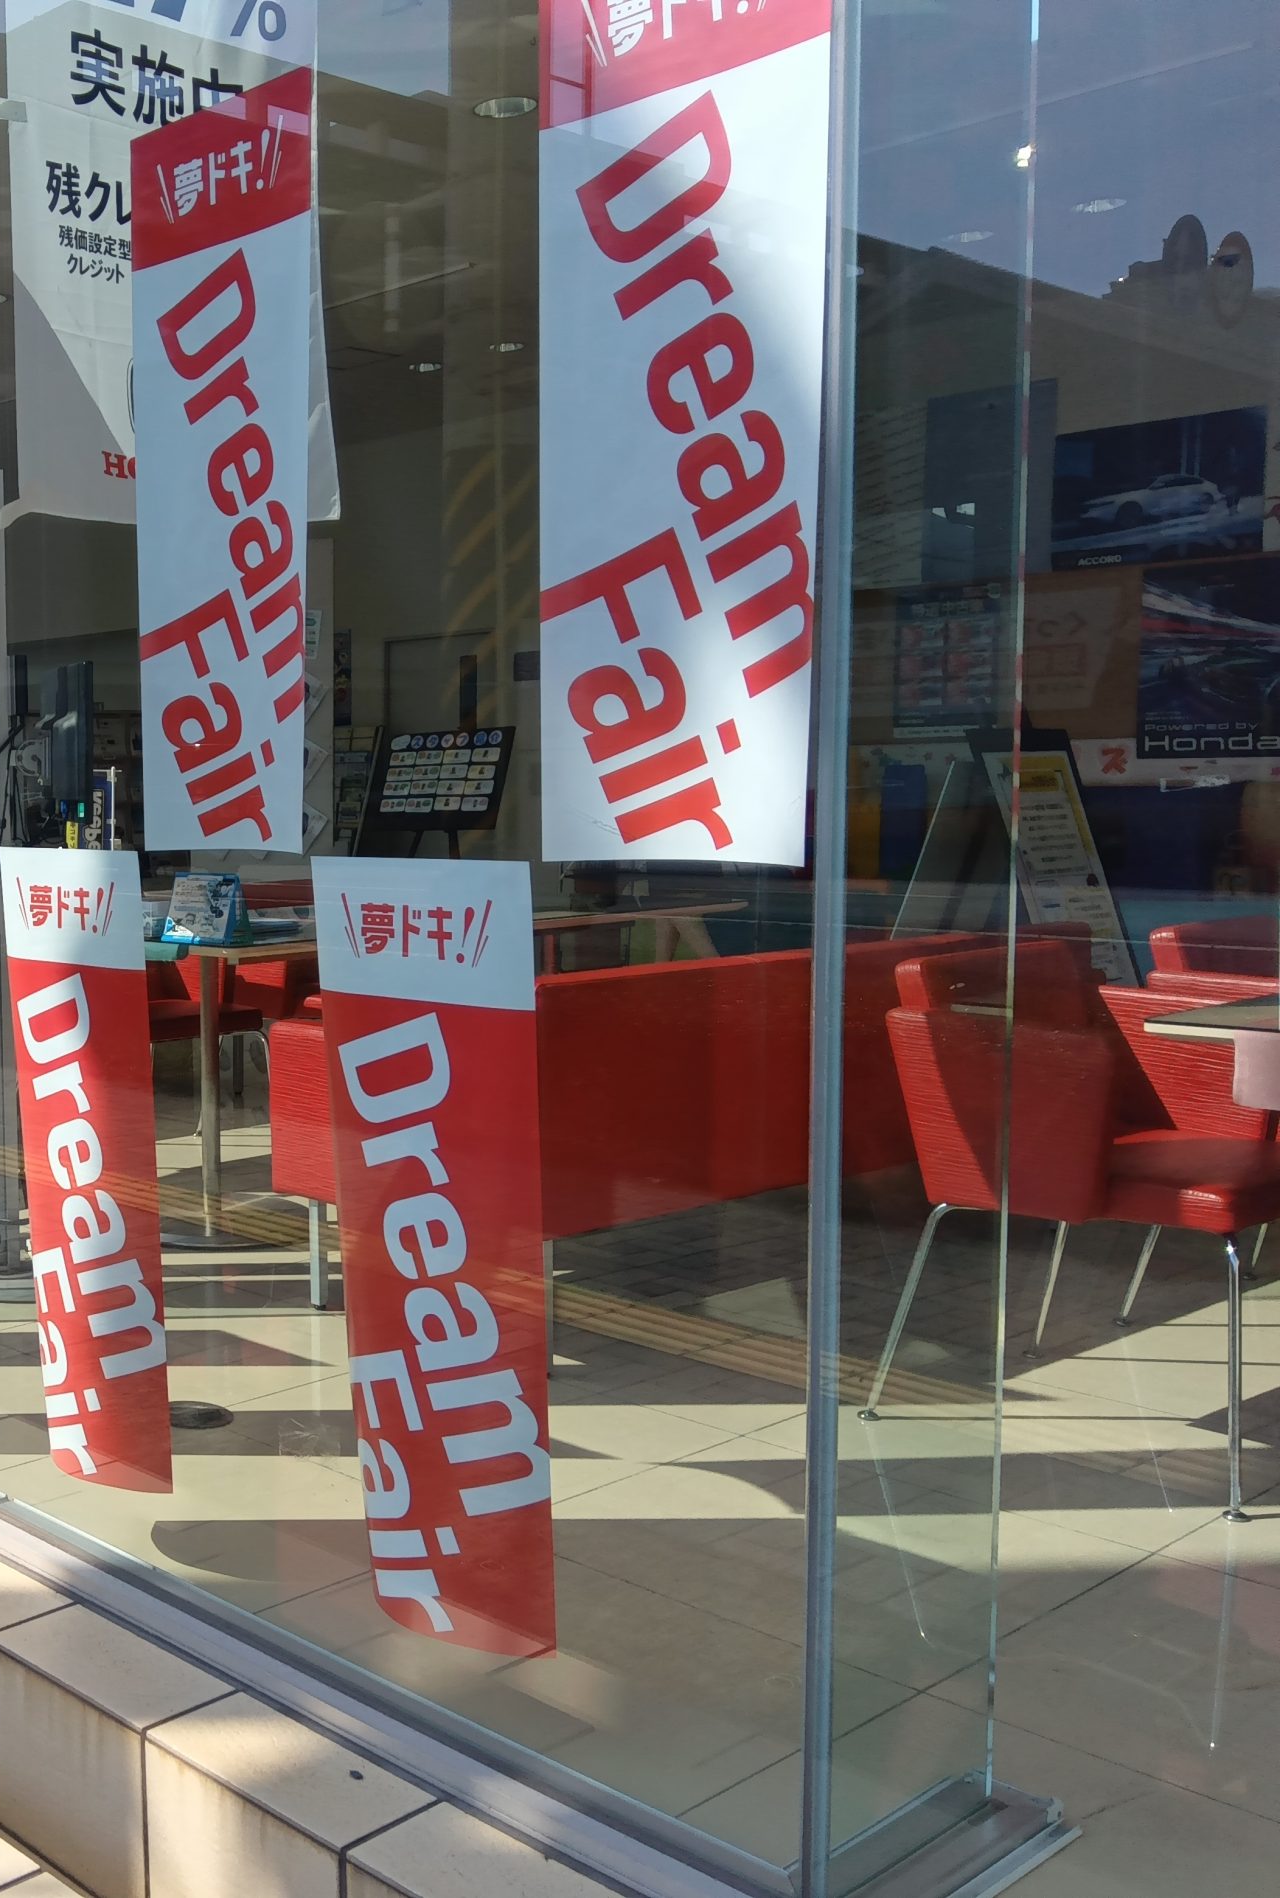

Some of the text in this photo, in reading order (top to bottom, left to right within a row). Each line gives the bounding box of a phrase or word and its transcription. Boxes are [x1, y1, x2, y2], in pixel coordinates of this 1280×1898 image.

[67, 253, 125, 284] クレジット
[575, 89, 814, 699] Dream
[140, 588, 275, 843] Fair
[540, 527, 741, 851] Fair
[1144, 732, 1280, 752] Honda
[1235, 721, 1259, 731] by
[17, 972, 167, 1380] Dream
[337, 1012, 551, 1517] Dream
